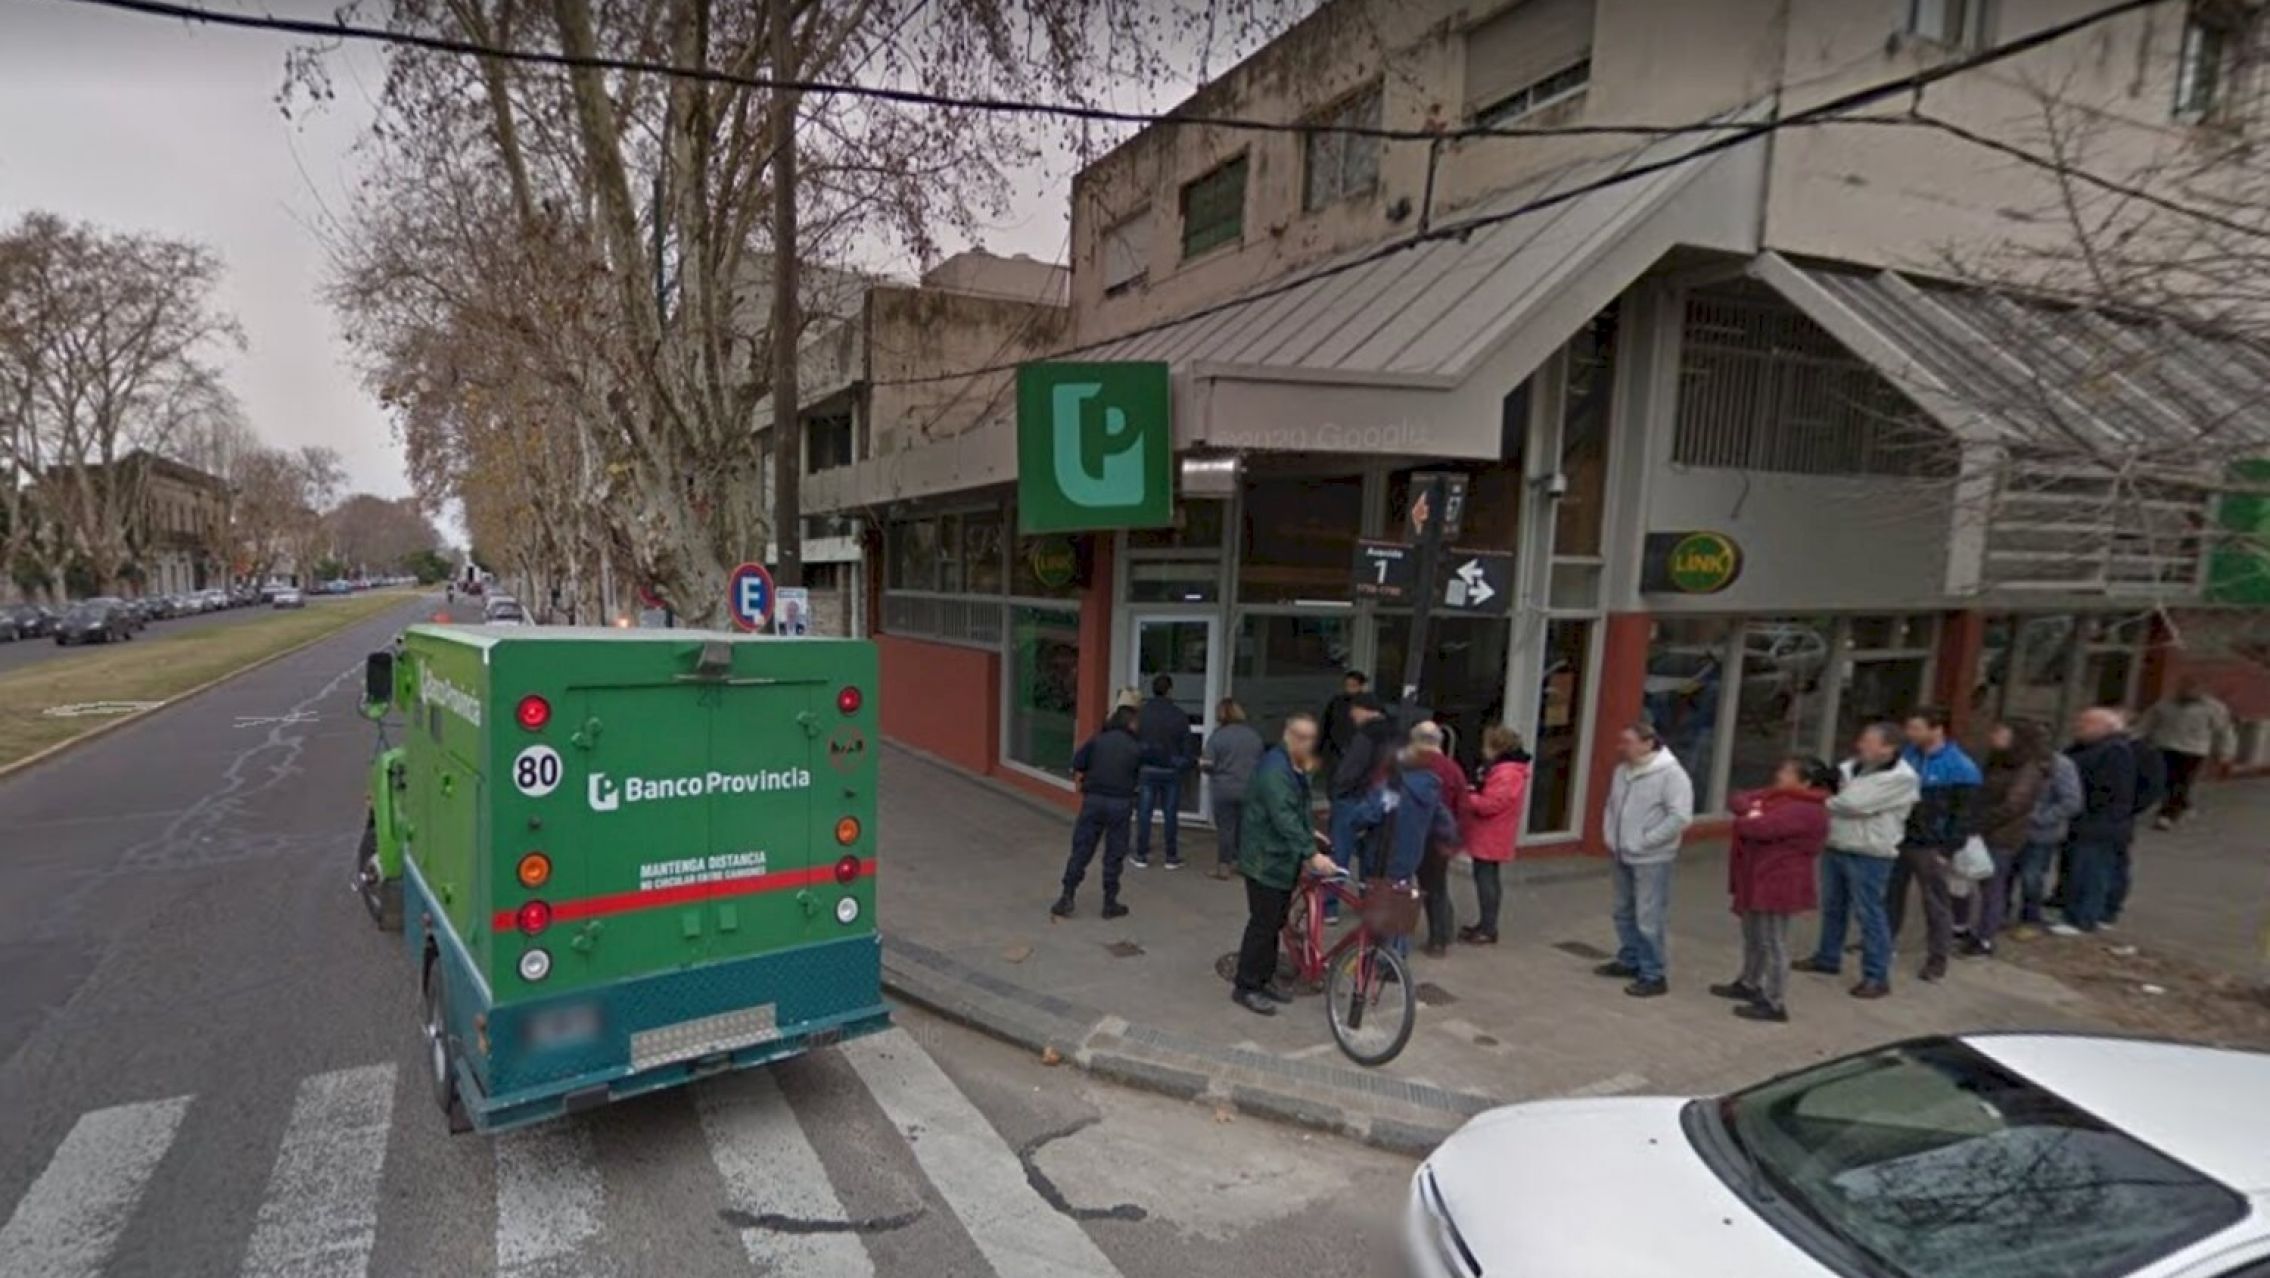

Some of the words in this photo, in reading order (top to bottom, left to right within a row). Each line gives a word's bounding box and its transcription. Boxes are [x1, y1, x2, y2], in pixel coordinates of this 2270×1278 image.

[1373, 559, 1389, 584] 1
[1674, 553, 1724, 573] LINK
[740, 576, 762, 616] E
[517, 754, 558, 789] 80
[625, 776, 702, 802] Banco
[706, 767, 811, 794] Provincia
[640, 857, 705, 879] MANTENGA
[708, 850, 767, 870] DISTANCIA
